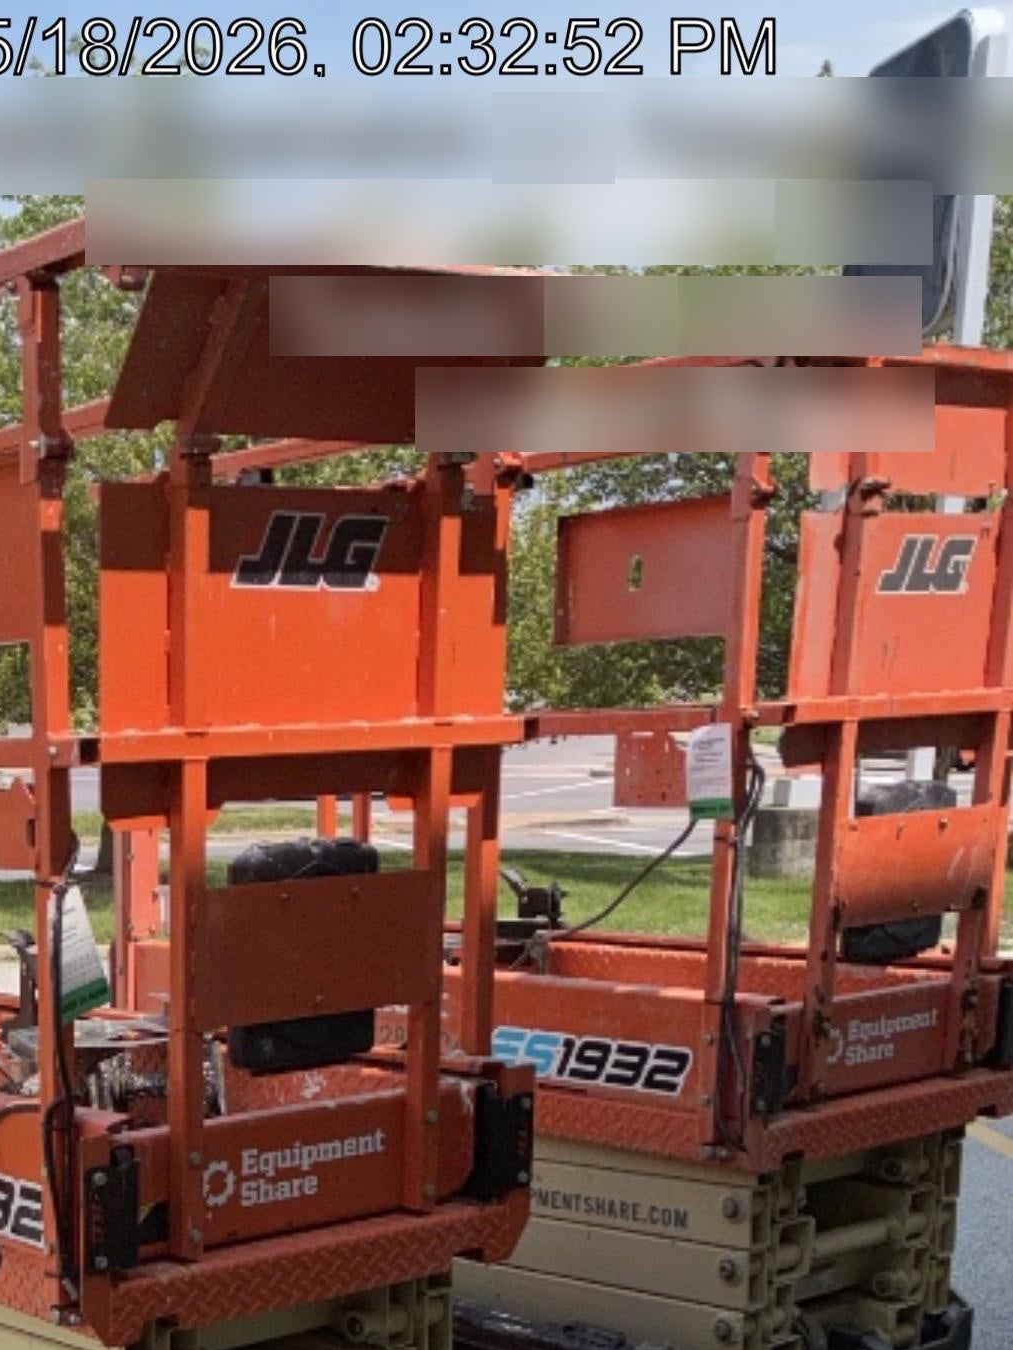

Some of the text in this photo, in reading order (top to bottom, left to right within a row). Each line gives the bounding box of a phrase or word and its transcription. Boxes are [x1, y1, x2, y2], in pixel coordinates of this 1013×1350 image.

[229, 512, 388, 592] JLG
[875, 534, 978, 594] JLG
[848, 1008, 938, 1041] Equipment
[492, 1026, 692, 1095] ES1932
[845, 1042, 894, 1066] Share
[241, 1128, 385, 1177] Equipment
[241, 1175, 318, 1206] Share
